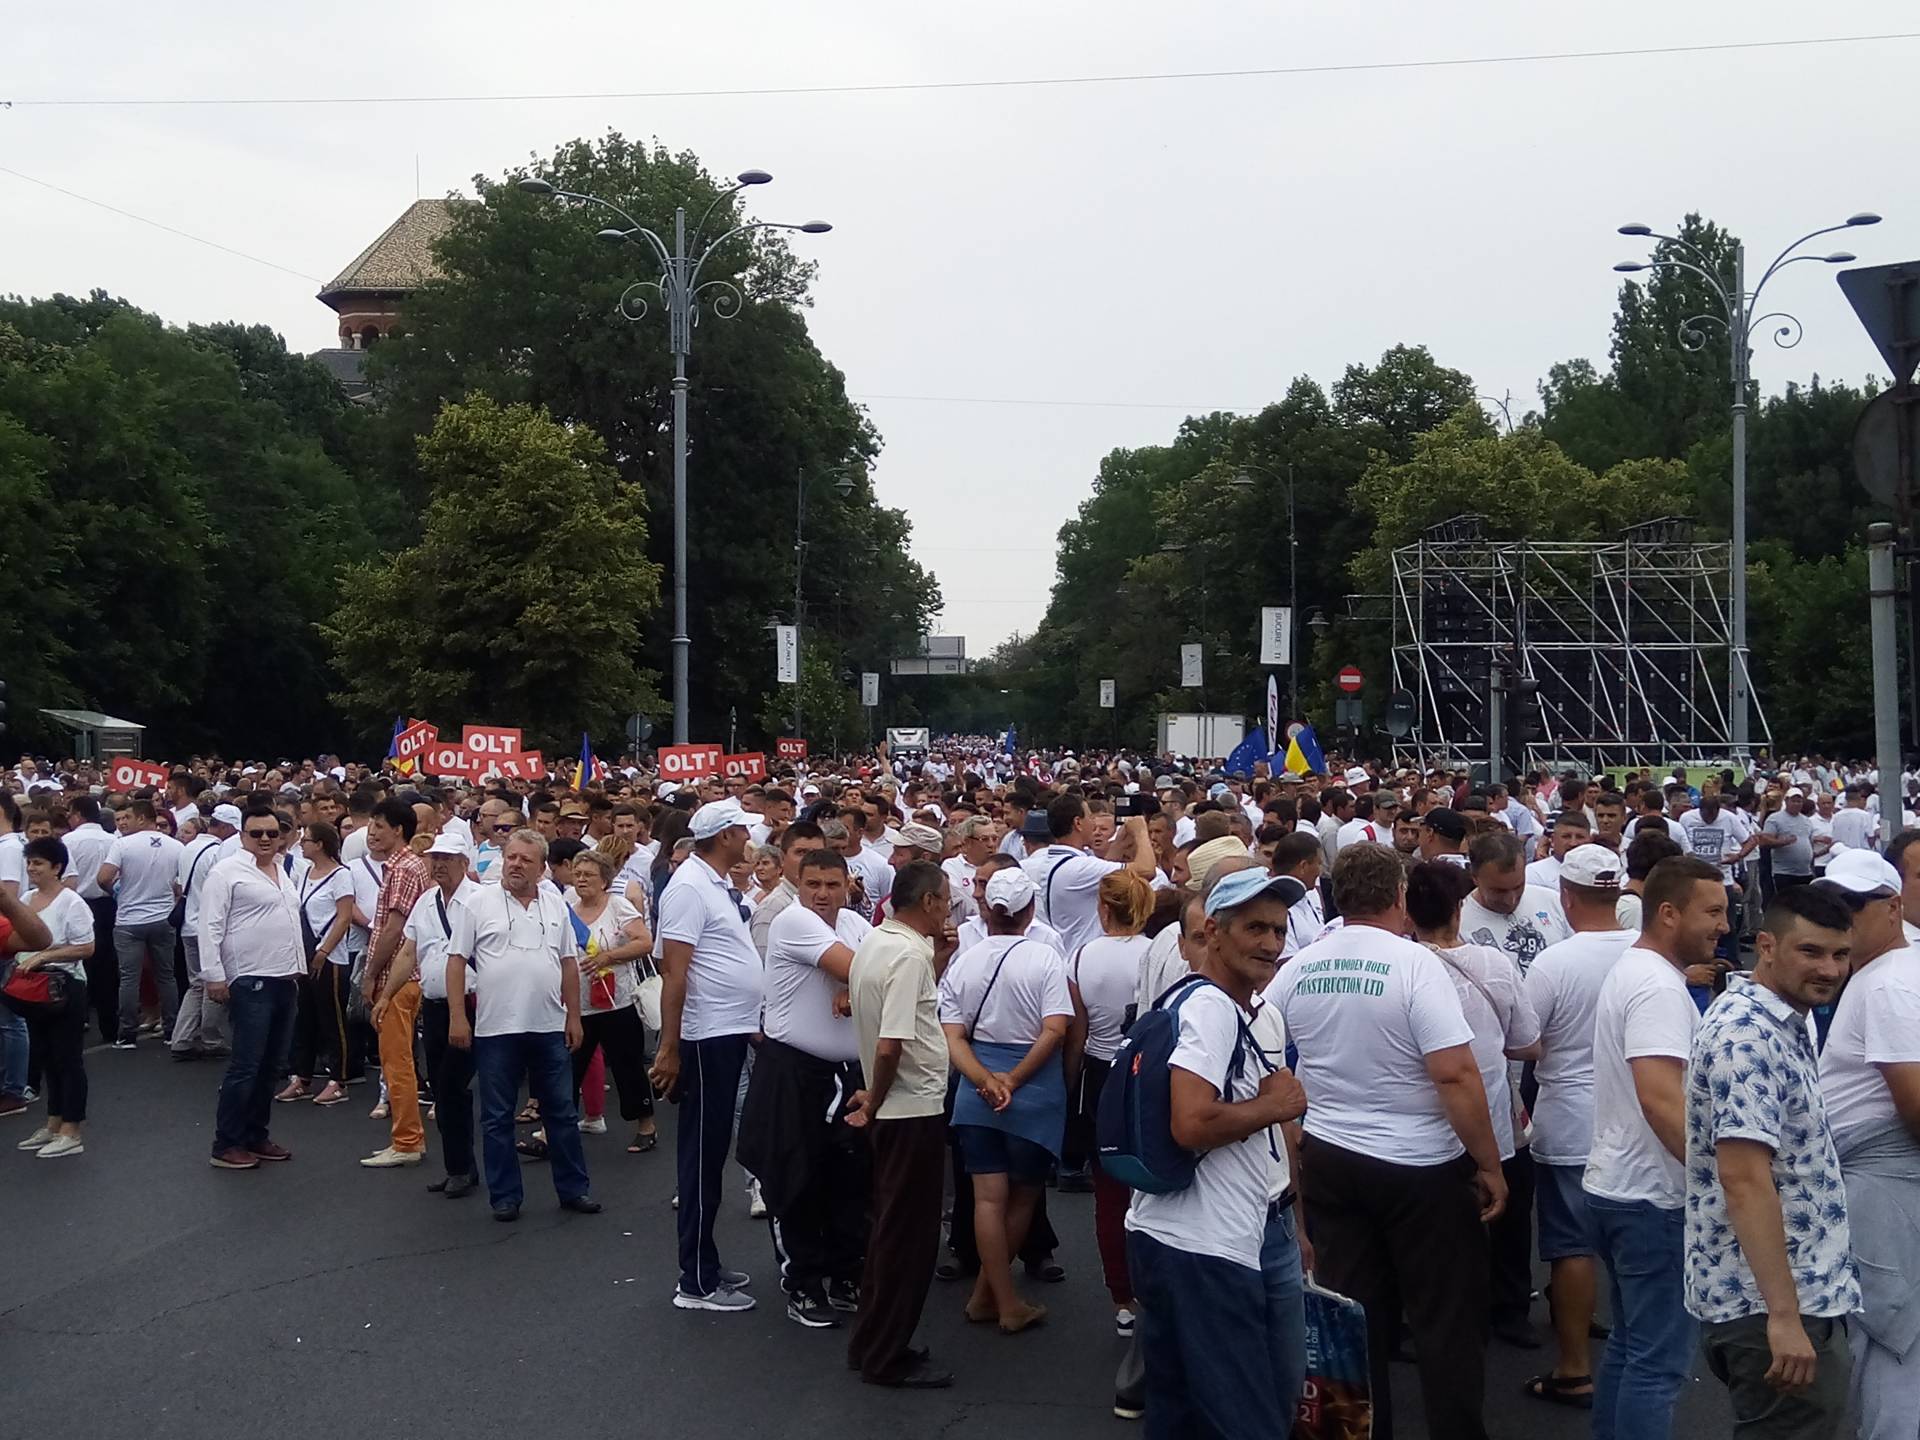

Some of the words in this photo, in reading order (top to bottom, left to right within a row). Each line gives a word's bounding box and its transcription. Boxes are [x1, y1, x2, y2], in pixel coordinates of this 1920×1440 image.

[400, 728, 427, 756] OLT
[468, 733, 516, 754] OLT
[779, 742, 804, 753] OLT
[664, 752, 705, 772] OLT
[726, 759, 760, 777] OLT
[116, 766, 163, 789] OLT
[1334, 958, 1364, 971] WOODEN
[1364, 960, 1391, 976] HOUSE
[1363, 978, 1384, 996] LTD
